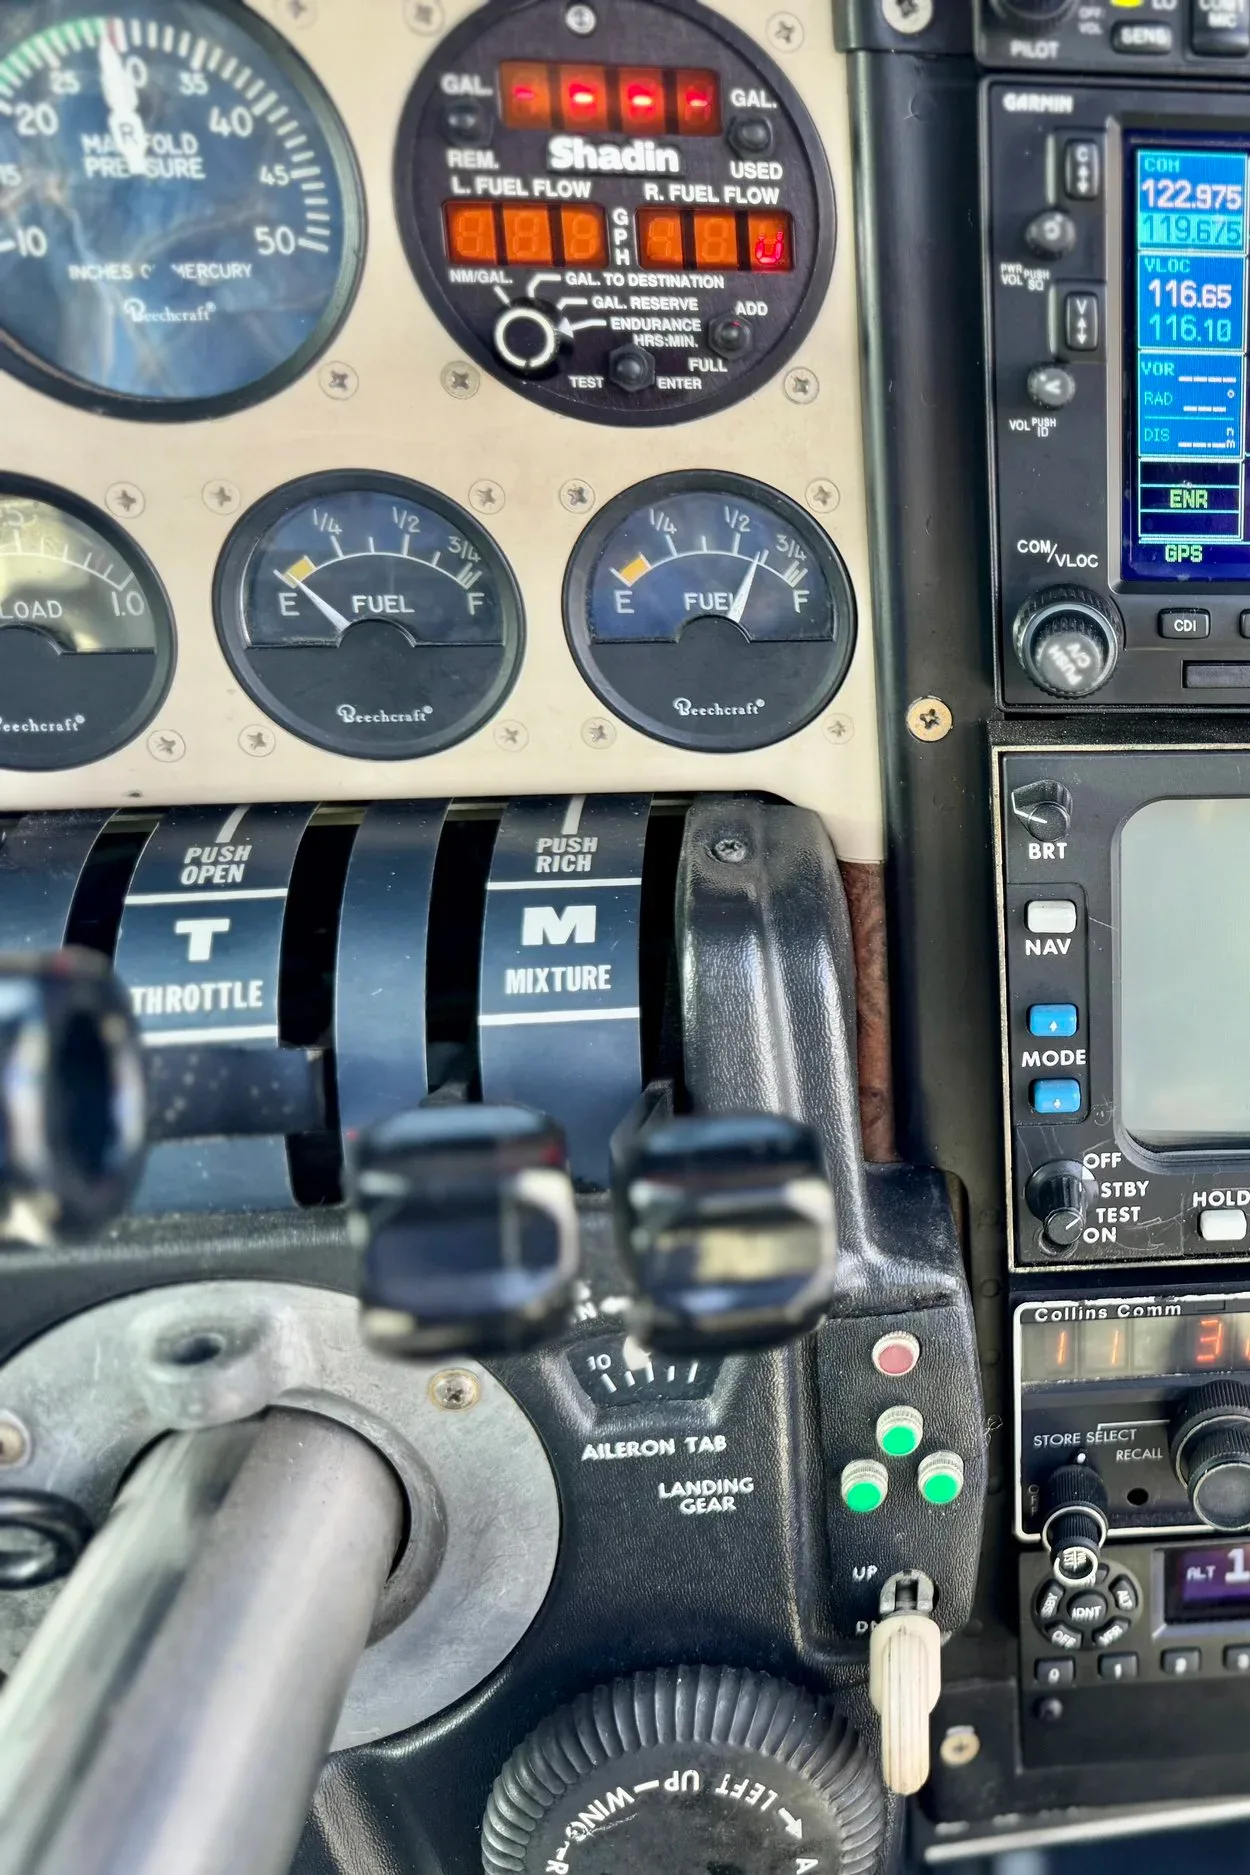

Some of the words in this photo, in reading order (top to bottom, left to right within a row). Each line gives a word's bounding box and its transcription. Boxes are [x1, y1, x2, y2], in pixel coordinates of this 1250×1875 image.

[1208, 13, 1237, 29] MIC
[1010, 40, 1060, 59] PILOT
[51, 69, 80, 95] 25
[179, 72, 209, 96] 35
[441, 74, 493, 97] GAL.
[731, 90, 778, 110] GAL.
[1003, 92, 1075, 114] GARMIN
[17, 104, 59, 136] 20
[209, 106, 254, 138] 40
[81, 133, 198, 156] MAFOLD
[548, 136, 680, 173] Shadin
[84, 157, 205, 180] PRESURE
[447, 149, 500, 169] REM.
[1144, 157, 1180, 173] COM
[259, 165, 290, 187] 45
[730, 162, 784, 181] USED
[451, 177, 472, 195] L.
[476, 177, 528, 197] FUEL
[534, 180, 591, 199] FLOW
[644, 184, 666, 203] R.
[670, 186, 720, 204] FUEL
[723, 187, 780, 206] FLOW
[1140, 178, 1243, 211] 122.975
[1140, 213, 1242, 245] 119.675
[17, 228, 47, 257] 10
[254, 226, 296, 255] 50
[69, 264, 133, 280] INCHES
[1001, 262, 1023, 274] PWR
[1024, 268, 1051, 280] PUSH
[1144, 257, 1191, 274] VLOC
[450, 269, 514, 286] NM/GAL.
[565, 273, 602, 288] GAL.
[604, 274, 625, 288] TO
[628, 274, 725, 290] DESTINATION
[1001, 274, 1024, 286] VOL
[592, 296, 627, 311] GAL.
[629, 297, 699, 312] RESERVE
[1148, 278, 1233, 310] 116.65
[735, 302, 768, 317] ADD
[610, 317, 702, 333] ENDURANCE
[1148, 314, 1233, 343] 116.10
[688, 357, 728, 373] FULL
[1141, 361, 1176, 377] VOR
[569, 376, 604, 390] TEST
[657, 376, 702, 391] ENTER
[1144, 391, 1174, 406] RAD
[1009, 418, 1031, 433] VOL
[1031, 416, 1057, 429] PUSH
[1144, 427, 1171, 443] DIS
[1169, 488, 1209, 510] ENR
[1164, 544, 1204, 564] GPS
[111, 590, 145, 618] 1.0
[279, 592, 300, 617] E
[351, 594, 416, 616] FUEL
[466, 592, 486, 616] F
[615, 589, 635, 615] E
[794, 590, 811, 614] F
[1173, 619, 1198, 633] CDI
[183, 845, 253, 865] PUSH
[536, 836, 599, 854] PUSH
[1027, 842, 1069, 861] BRT
[535, 854, 593, 873] RICH
[180, 863, 245, 885] OPEN
[521, 905, 597, 946] M
[174, 918, 231, 961] T
[1024, 938, 1072, 956] NAV
[504, 964, 612, 995] MIXTURE
[132, 981, 264, 1016] THROTTLE
[1021, 1048, 1088, 1068] MODE
[1082, 1152, 1123, 1170] OFF
[1100, 1180, 1150, 1199] STBY
[1095, 1206, 1141, 1224] TEST
[1083, 1226, 1117, 1244] ON
[1034, 1305, 1108, 1323] Collins
[1116, 1302, 1182, 1318] Comm
[586, 1353, 612, 1372] 10
[580, 1437, 676, 1462] AILERON
[684, 1434, 728, 1455] TAB
[1033, 1432, 1082, 1448] STORE
[1086, 1428, 1138, 1444] SELECT
[1115, 1447, 1164, 1463] RECALL
[658, 1476, 755, 1499] LANDING
[679, 1496, 737, 1516] GEAR
[852, 1564, 879, 1582] UP
[1186, 1565, 1215, 1583] ALT
[1071, 1604, 1103, 1621] IDNT
[663, 1768, 701, 1793] UP
[713, 1772, 779, 1813] LEFT
[565, 1785, 636, 1843] WING
